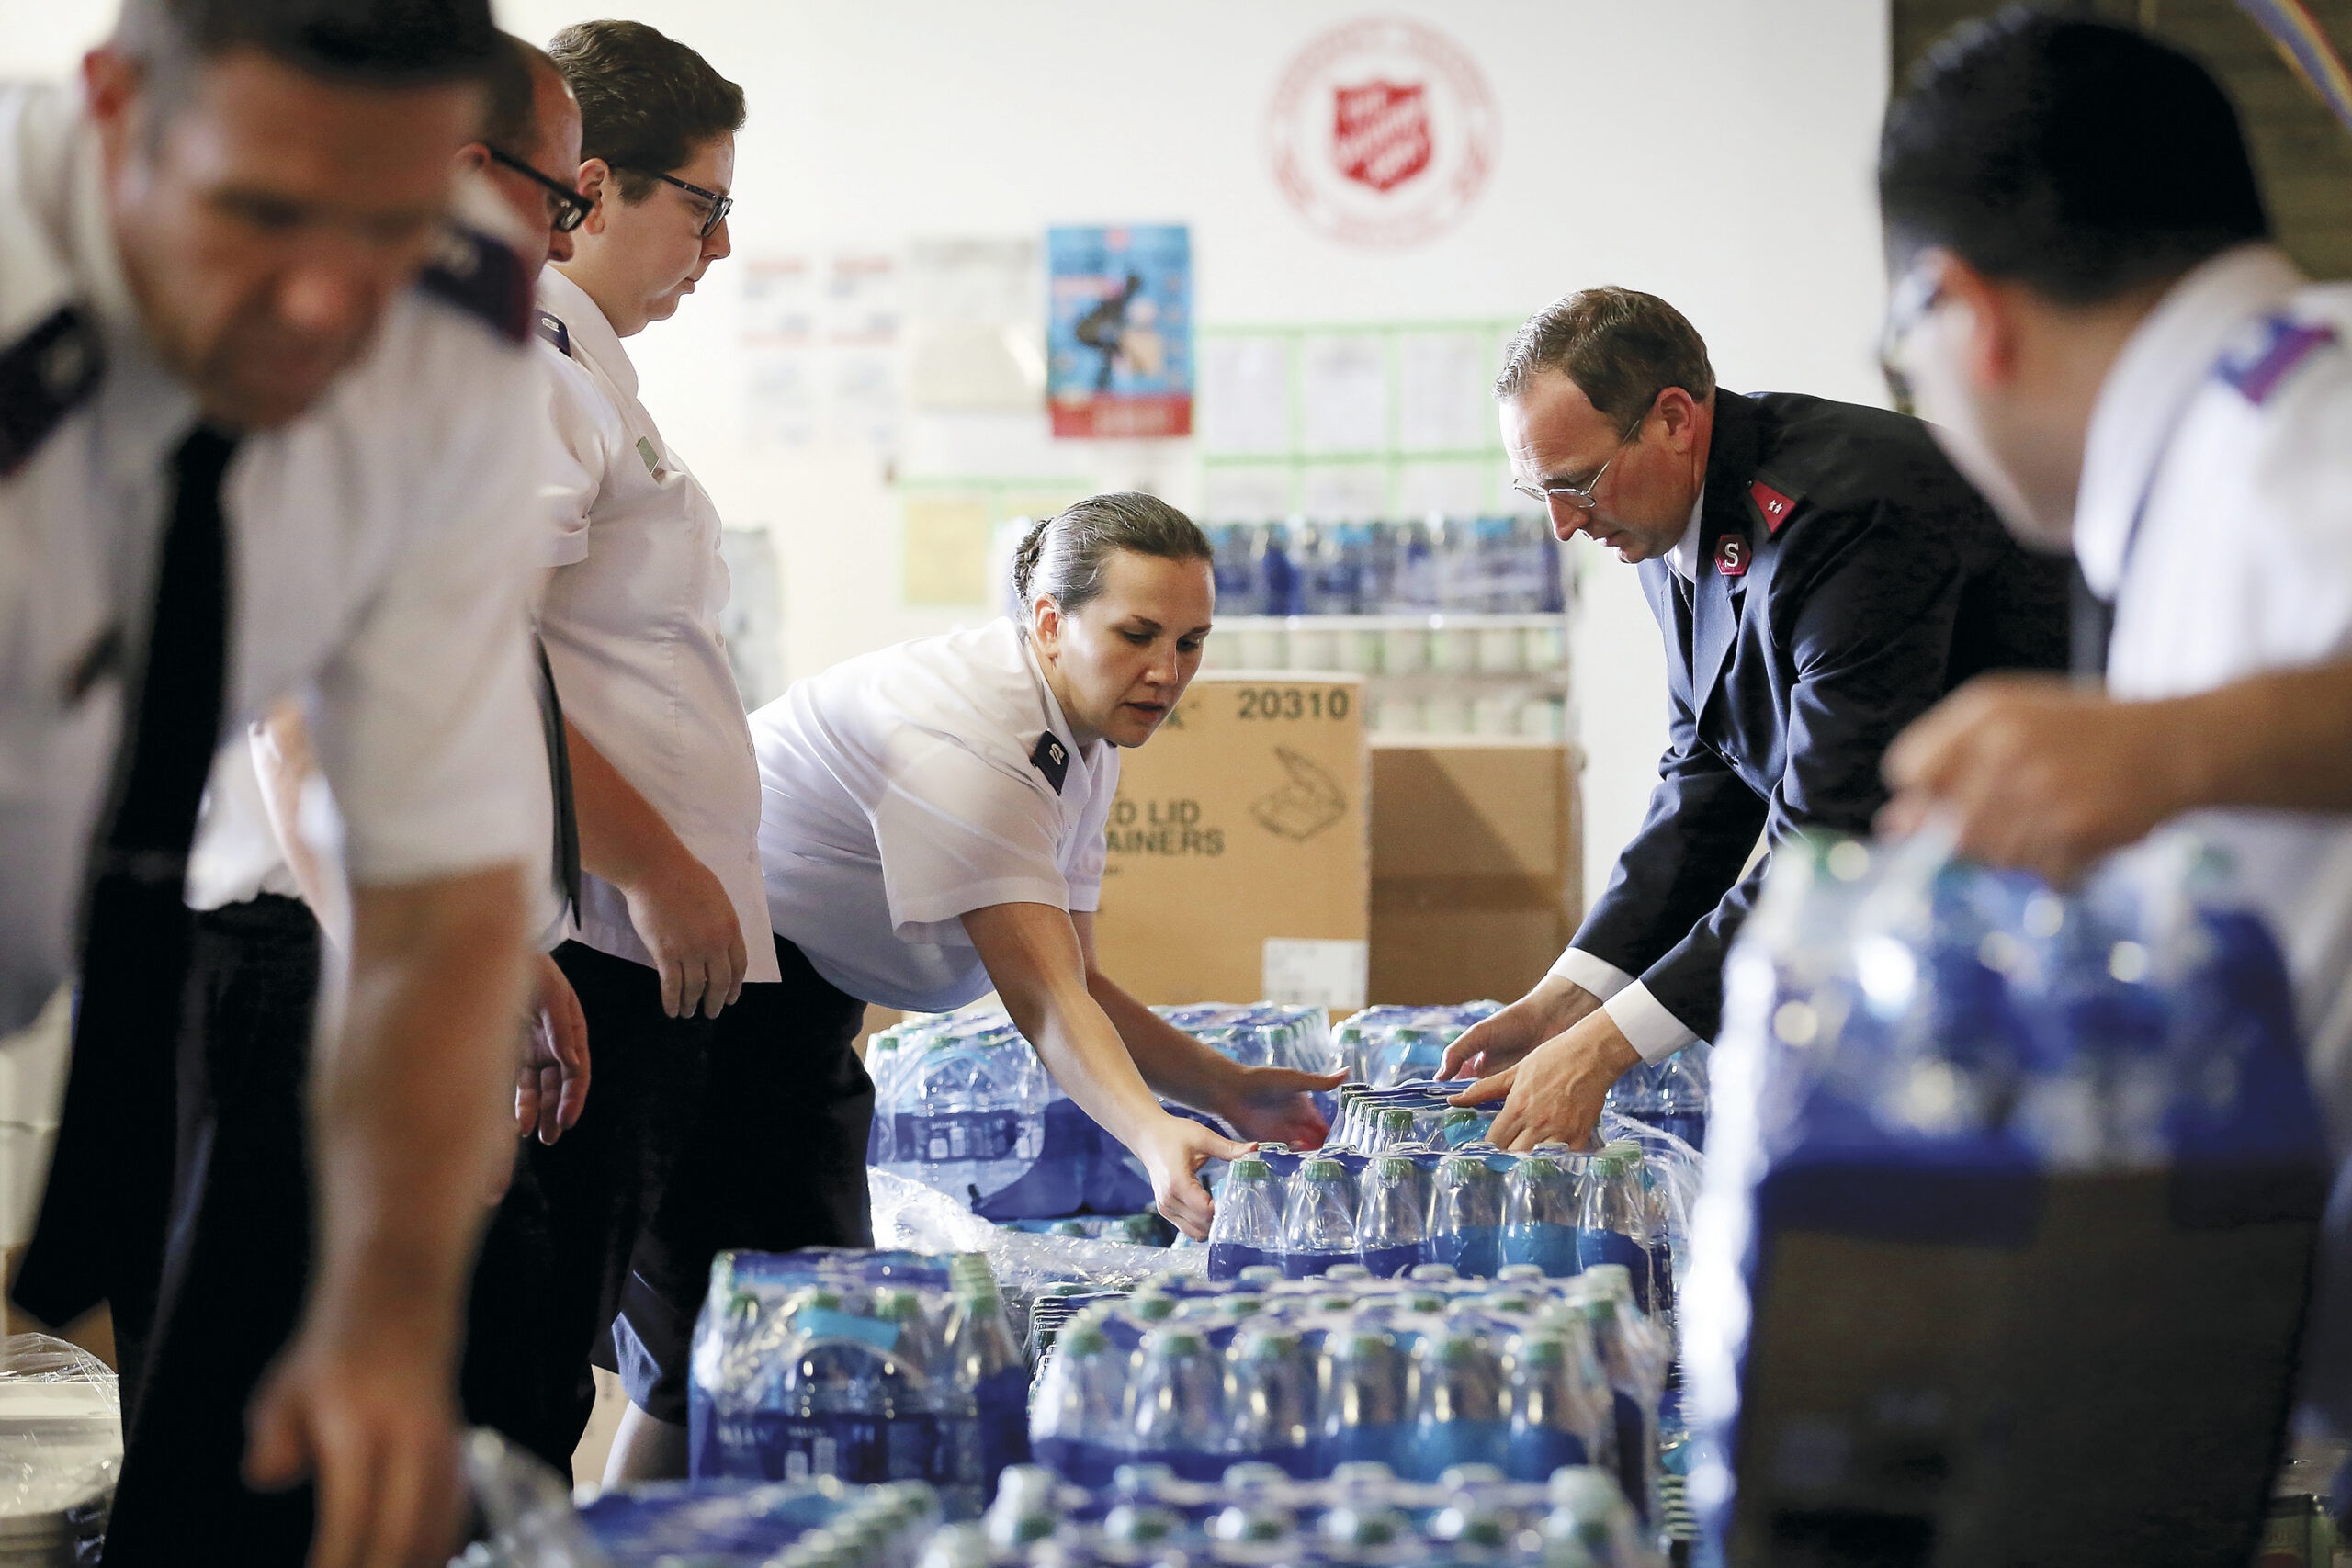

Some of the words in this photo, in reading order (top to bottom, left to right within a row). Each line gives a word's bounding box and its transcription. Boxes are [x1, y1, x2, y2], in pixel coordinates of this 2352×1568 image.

[1724, 542, 1740, 568] S
[1238, 688, 1350, 720] 20310
[1114, 799, 1137, 826] D
[1148, 799, 1202, 826] LID
[1106, 829, 1226, 856] AINERS
